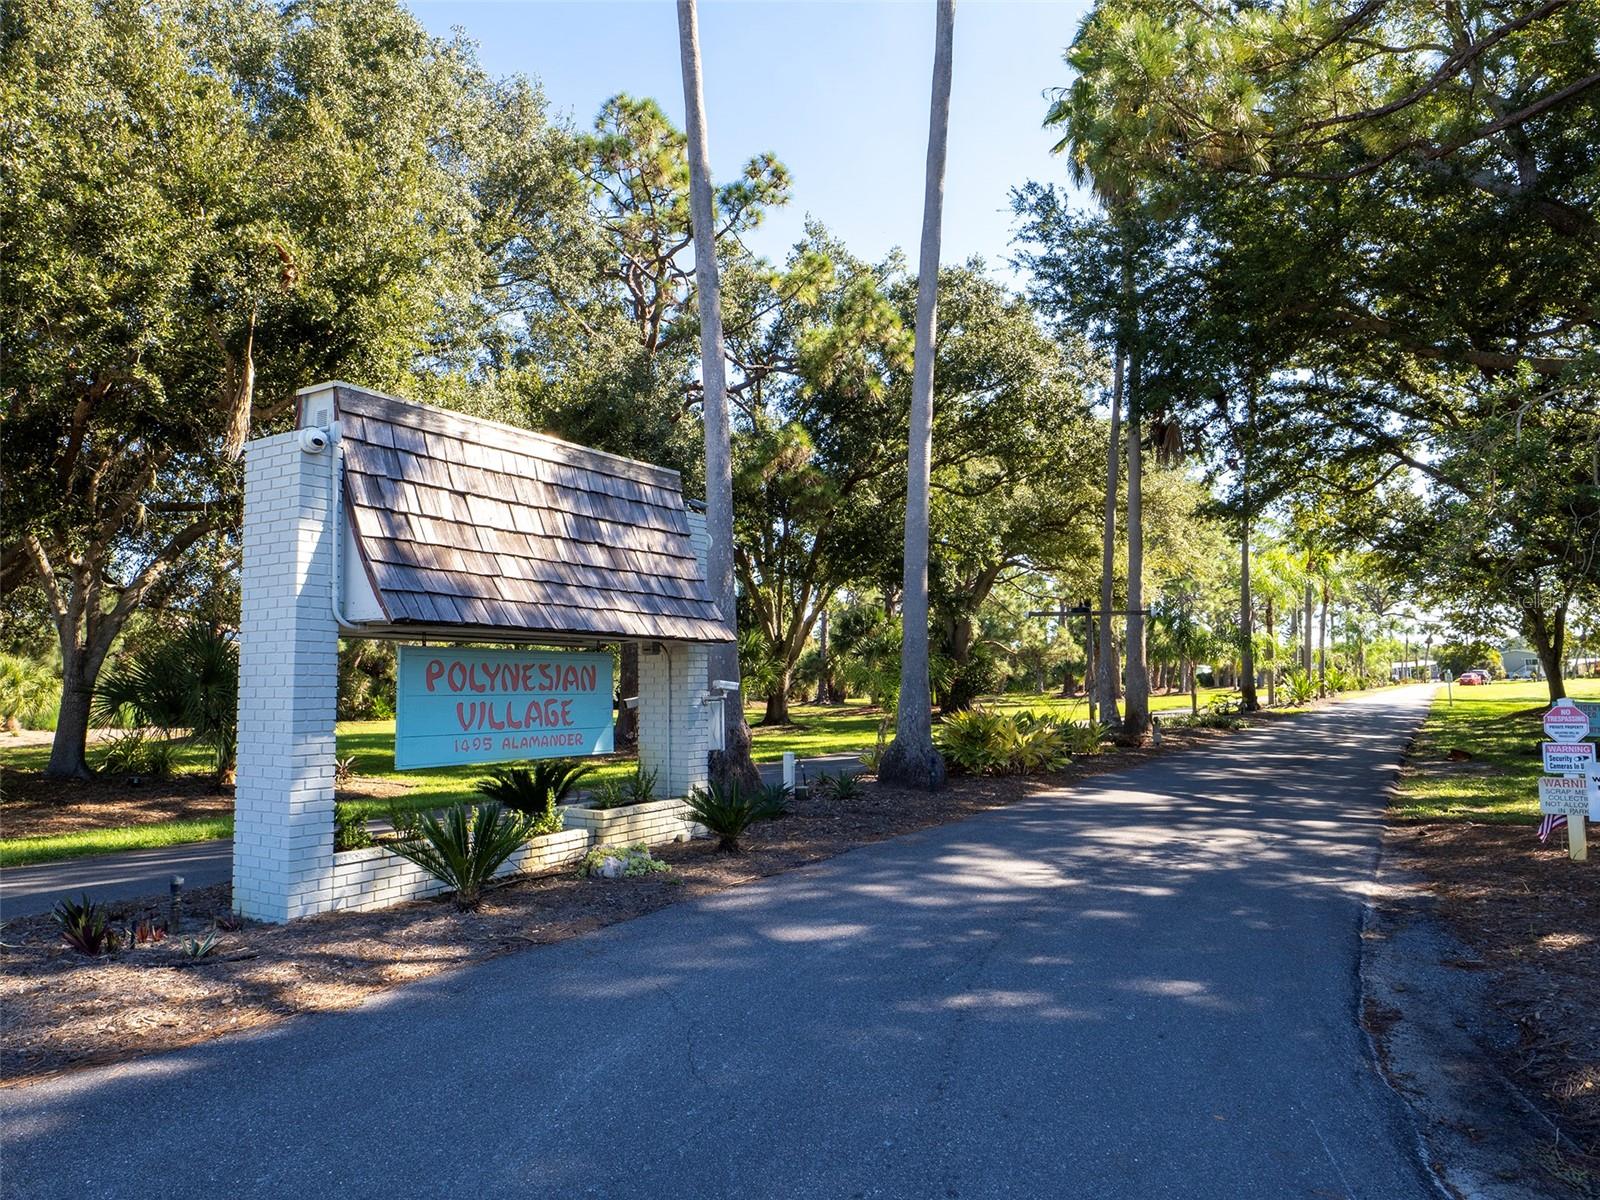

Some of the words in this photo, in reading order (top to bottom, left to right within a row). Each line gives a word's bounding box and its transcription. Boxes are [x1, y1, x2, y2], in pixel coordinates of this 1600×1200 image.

[425, 659, 597, 693] POLYNESIAN
[456, 698, 575, 731] VILLAGE
[454, 737, 493, 753] 1495
[502, 733, 584, 750] ALAMANDER
[1546, 745, 1591, 753] WARNING
[1549, 755, 1572, 763] Security
[1543, 779, 1587, 788] WARNI
